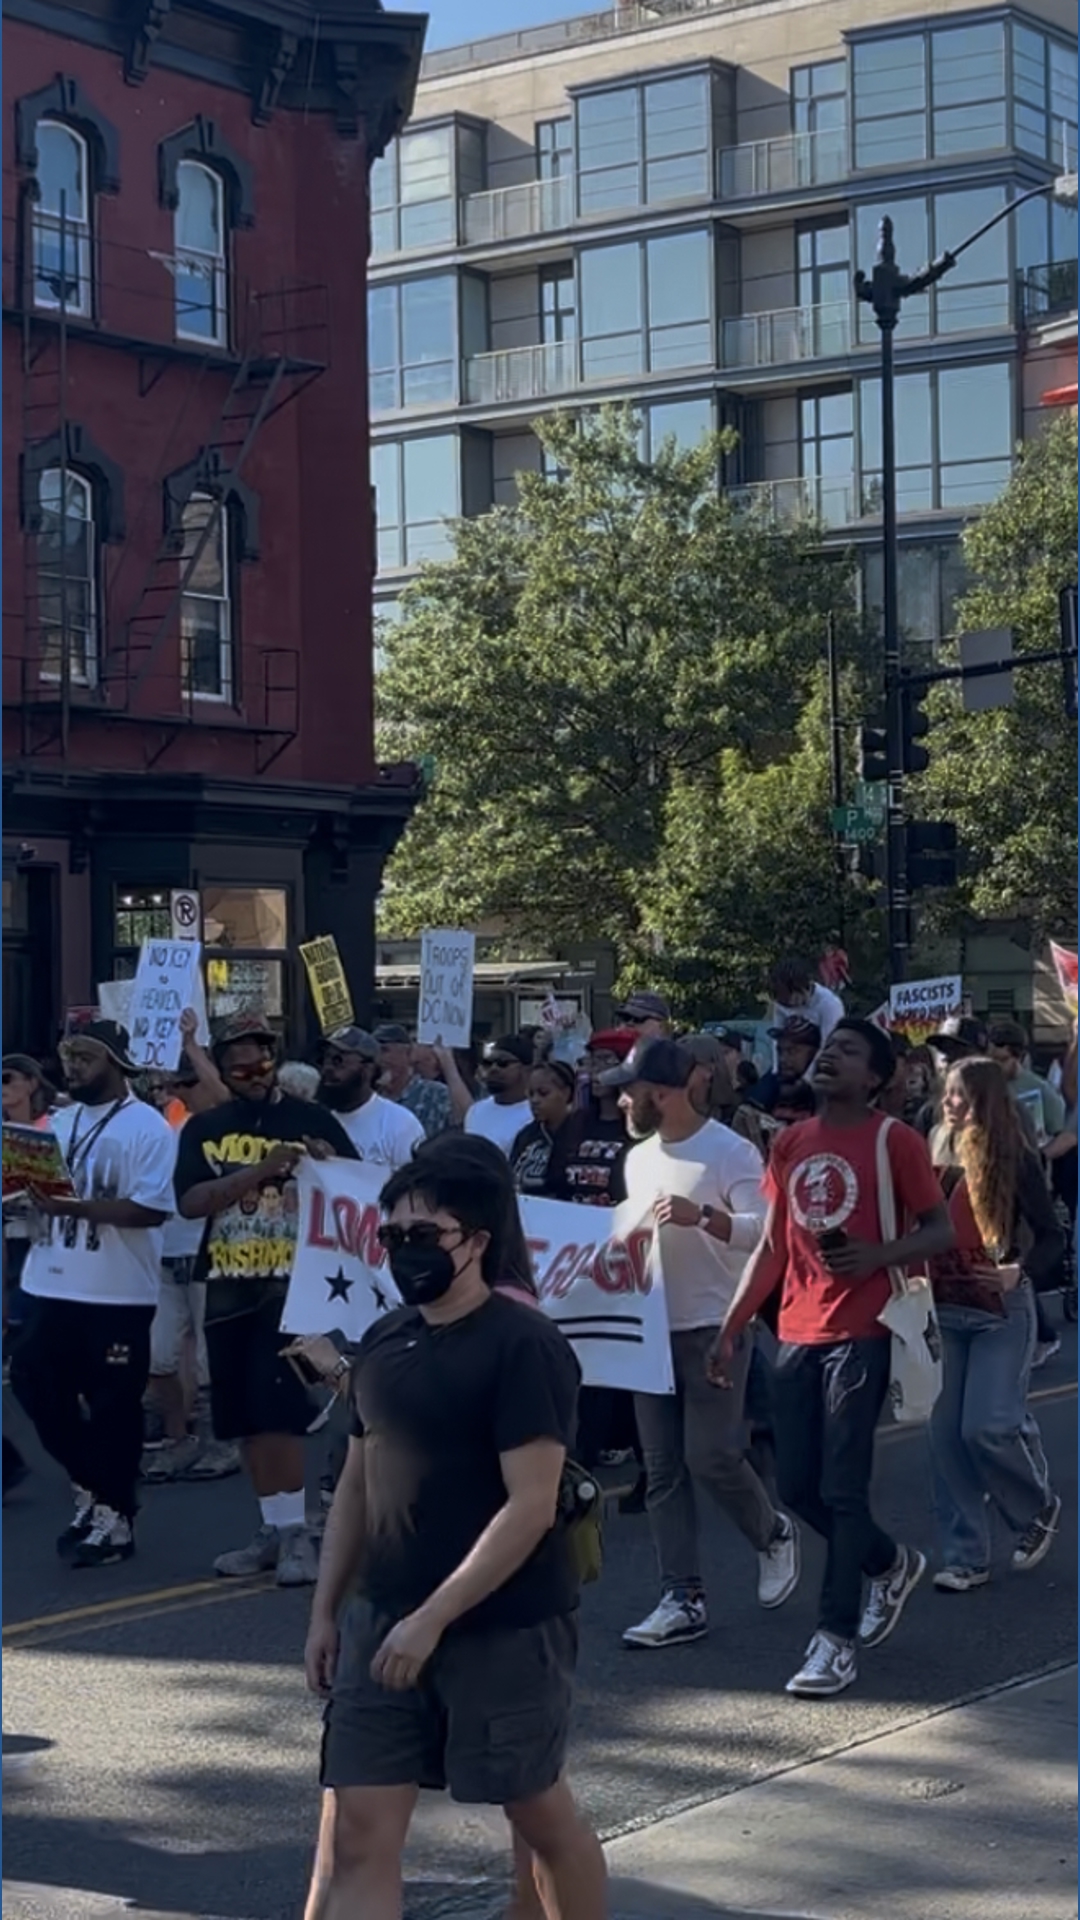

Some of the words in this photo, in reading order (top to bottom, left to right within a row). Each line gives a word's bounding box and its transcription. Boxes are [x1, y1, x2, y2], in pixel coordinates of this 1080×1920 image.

[847, 810, 858, 827] P
[844, 827, 876, 840] 1400
[148, 946, 168, 967] NO
[425, 939, 469, 967] TROOPS
[897, 982, 955, 1006] FASCISTS
[421, 998, 441, 1024] DC
[132, 1017, 150, 1038] NO
[142, 1041, 166, 1067] DC
